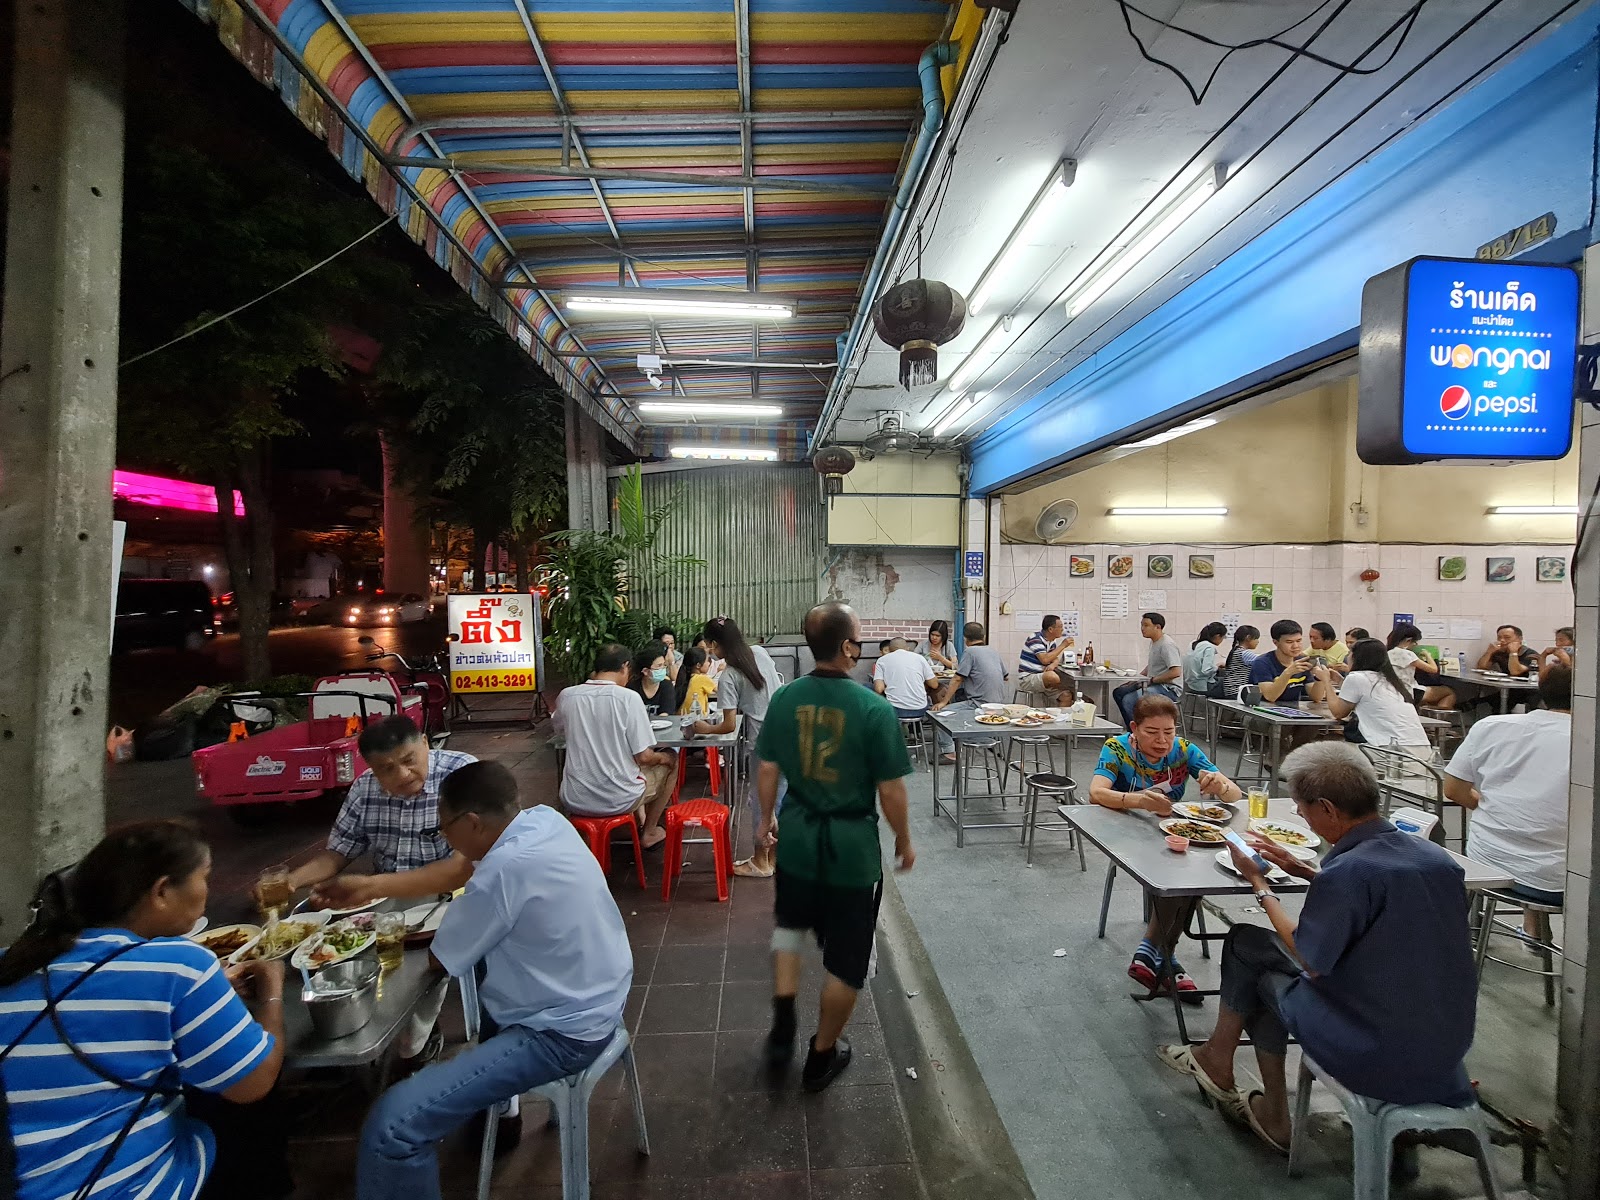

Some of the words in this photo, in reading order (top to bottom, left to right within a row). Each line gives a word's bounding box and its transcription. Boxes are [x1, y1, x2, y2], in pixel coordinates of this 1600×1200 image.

[1480, 217, 1549, 259] 98/14
[1450, 281, 1536, 311] ร้านเด็ด
[1472, 314, 1514, 326] แนะนำโดย
[1430, 344, 1550, 375] wongnai
[1474, 393, 1537, 417] pepsi
[455, 650, 531, 665] ข้าวต้มหัวปลา
[455, 674, 533, 689] 02-413-3291
[796, 705, 845, 783] 12
